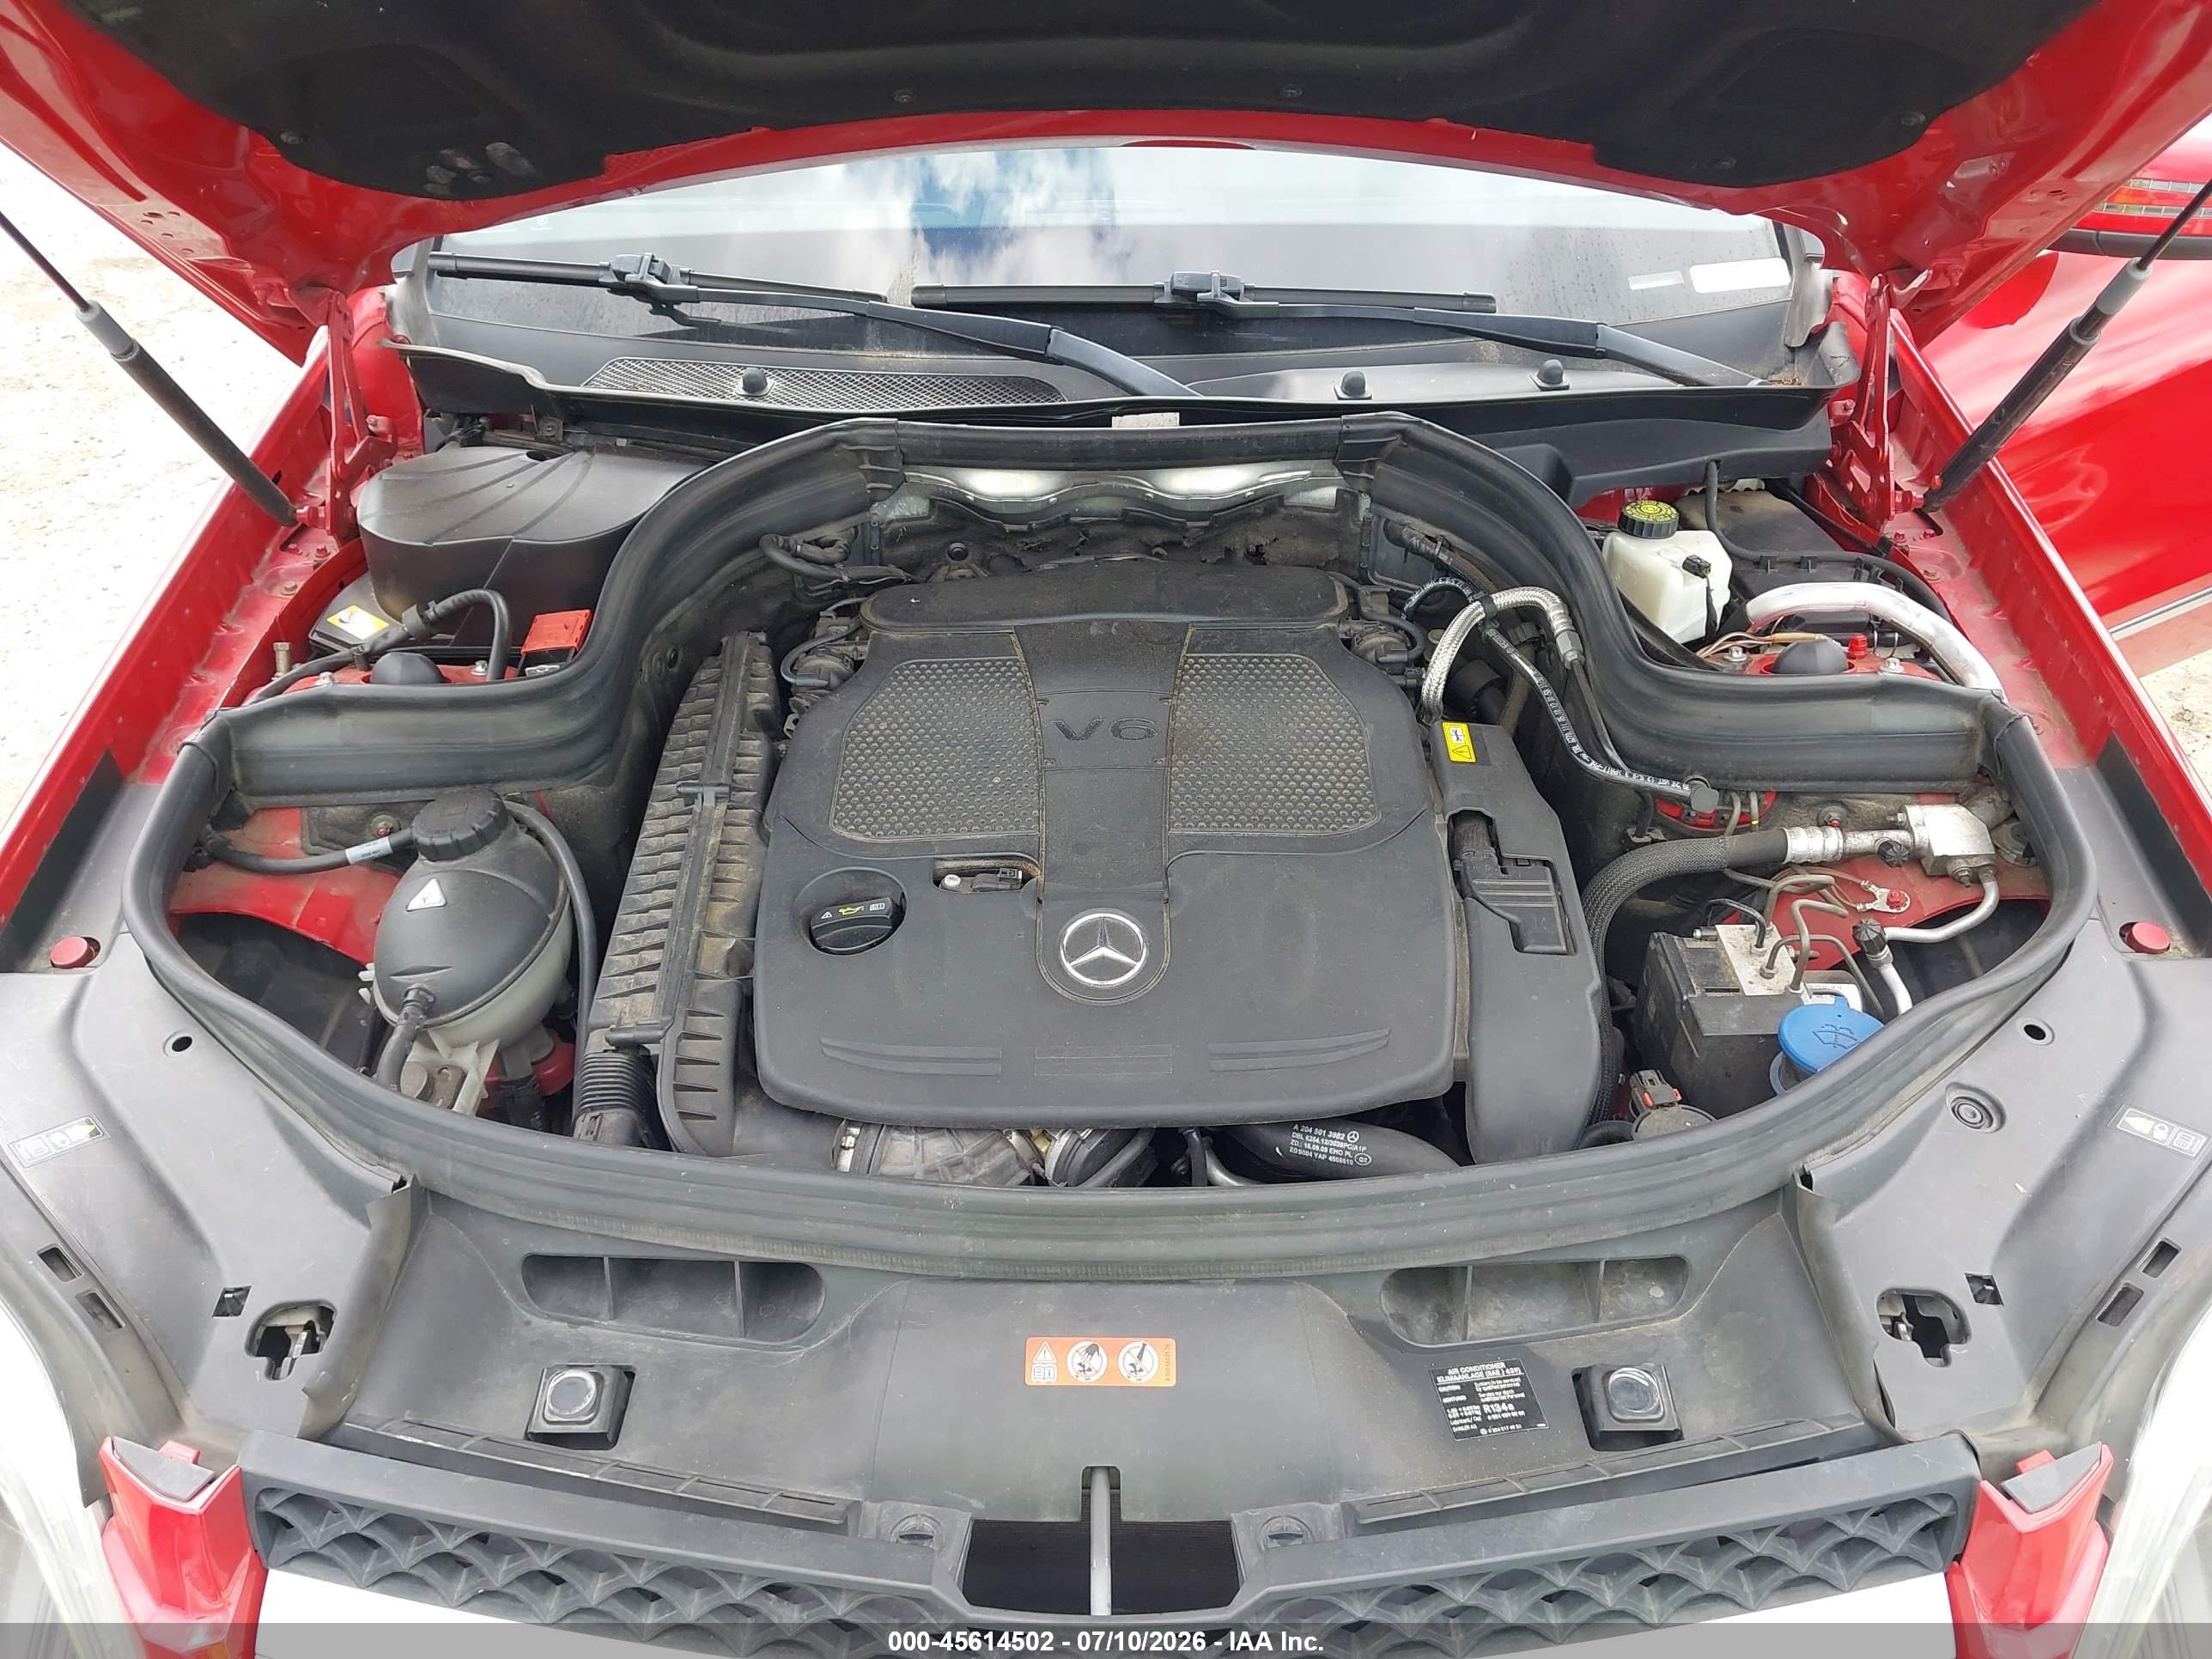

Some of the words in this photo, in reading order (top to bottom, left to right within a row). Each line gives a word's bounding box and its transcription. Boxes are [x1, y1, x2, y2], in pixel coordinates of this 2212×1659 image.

[1052, 716, 1158, 740] V6
[1328, 1131, 1345, 1140] 3982
[1460, 1362, 1505, 1374] CONDITIONER
[1437, 1371, 1485, 1382] KLIMAANLAGE
[1483, 1402, 1515, 1413] R134a
